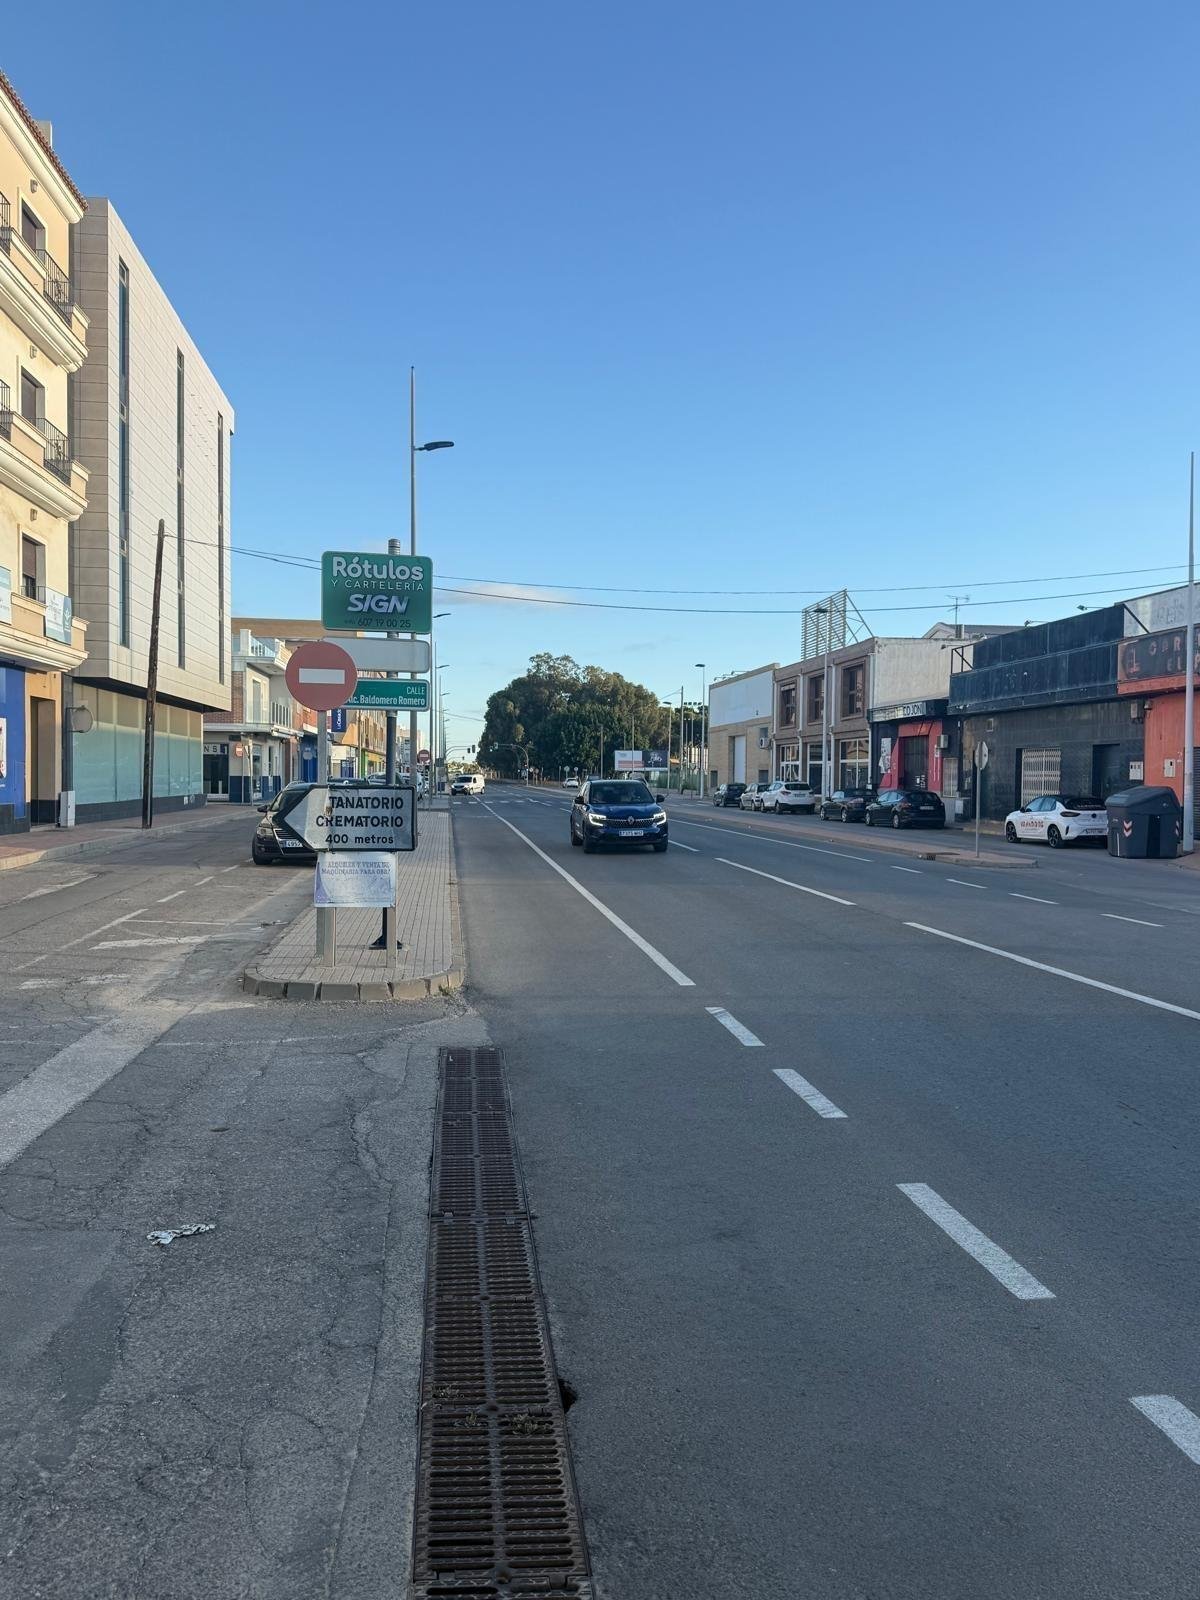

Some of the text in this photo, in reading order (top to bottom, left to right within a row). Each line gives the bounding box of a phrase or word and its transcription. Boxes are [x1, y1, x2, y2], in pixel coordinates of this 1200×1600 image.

[332, 556, 424, 581] Rótulos
[331, 579, 424, 591] Y CARTELERÍA
[347, 593, 409, 614] SIGN
[399, 619, 411, 628] 25
[406, 686, 425, 695] CALLE
[360, 694, 397, 705] Baldomero
[398, 696, 425, 706] Romero
[329, 796, 404, 810] TANATORIO
[316, 815, 404, 828] CREMATORIO
[325, 834, 394, 844] 400 metros
